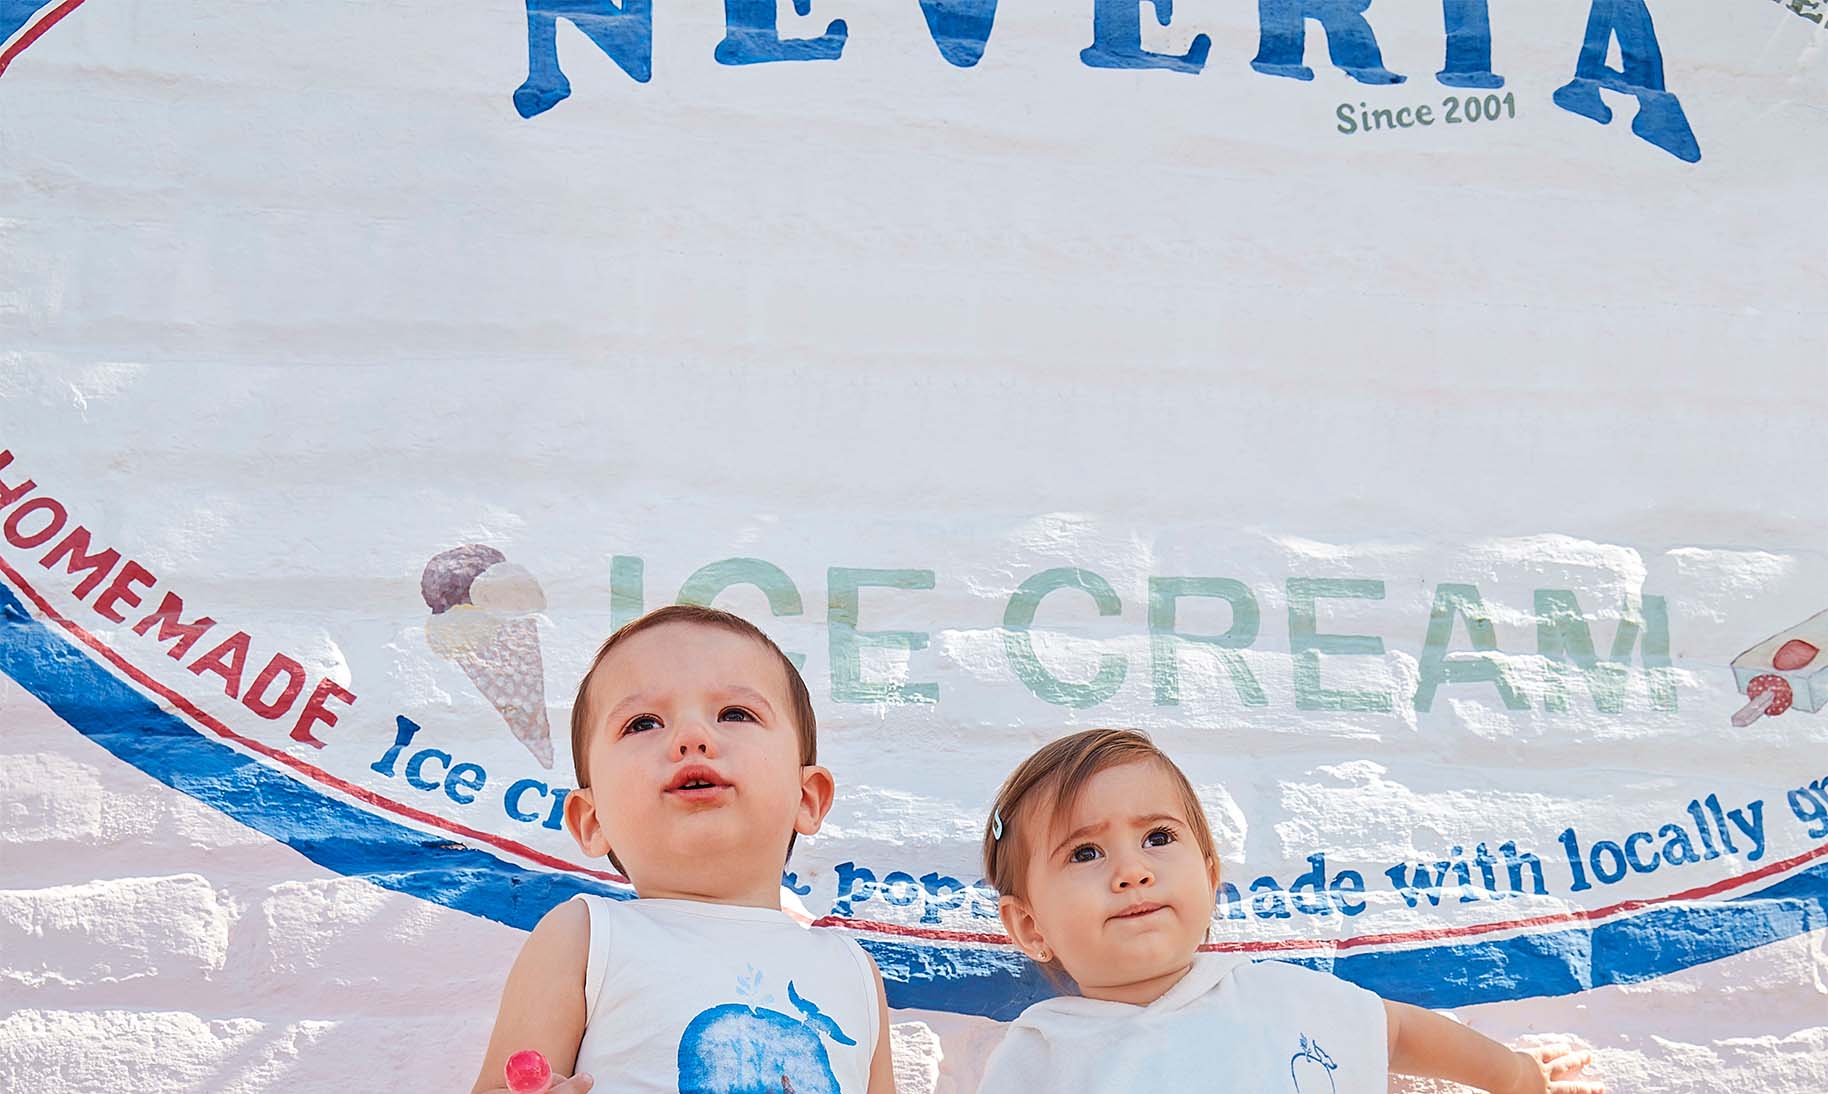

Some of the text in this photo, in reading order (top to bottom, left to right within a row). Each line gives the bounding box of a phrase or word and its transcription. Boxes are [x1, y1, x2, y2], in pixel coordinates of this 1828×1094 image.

[1336, 92, 1516, 135] Since 2001
[1003, 567, 1678, 713] CREAM
[370, 715, 487, 805] Ice
[1385, 840, 1549, 909] with
[1558, 793, 1765, 892] locally
